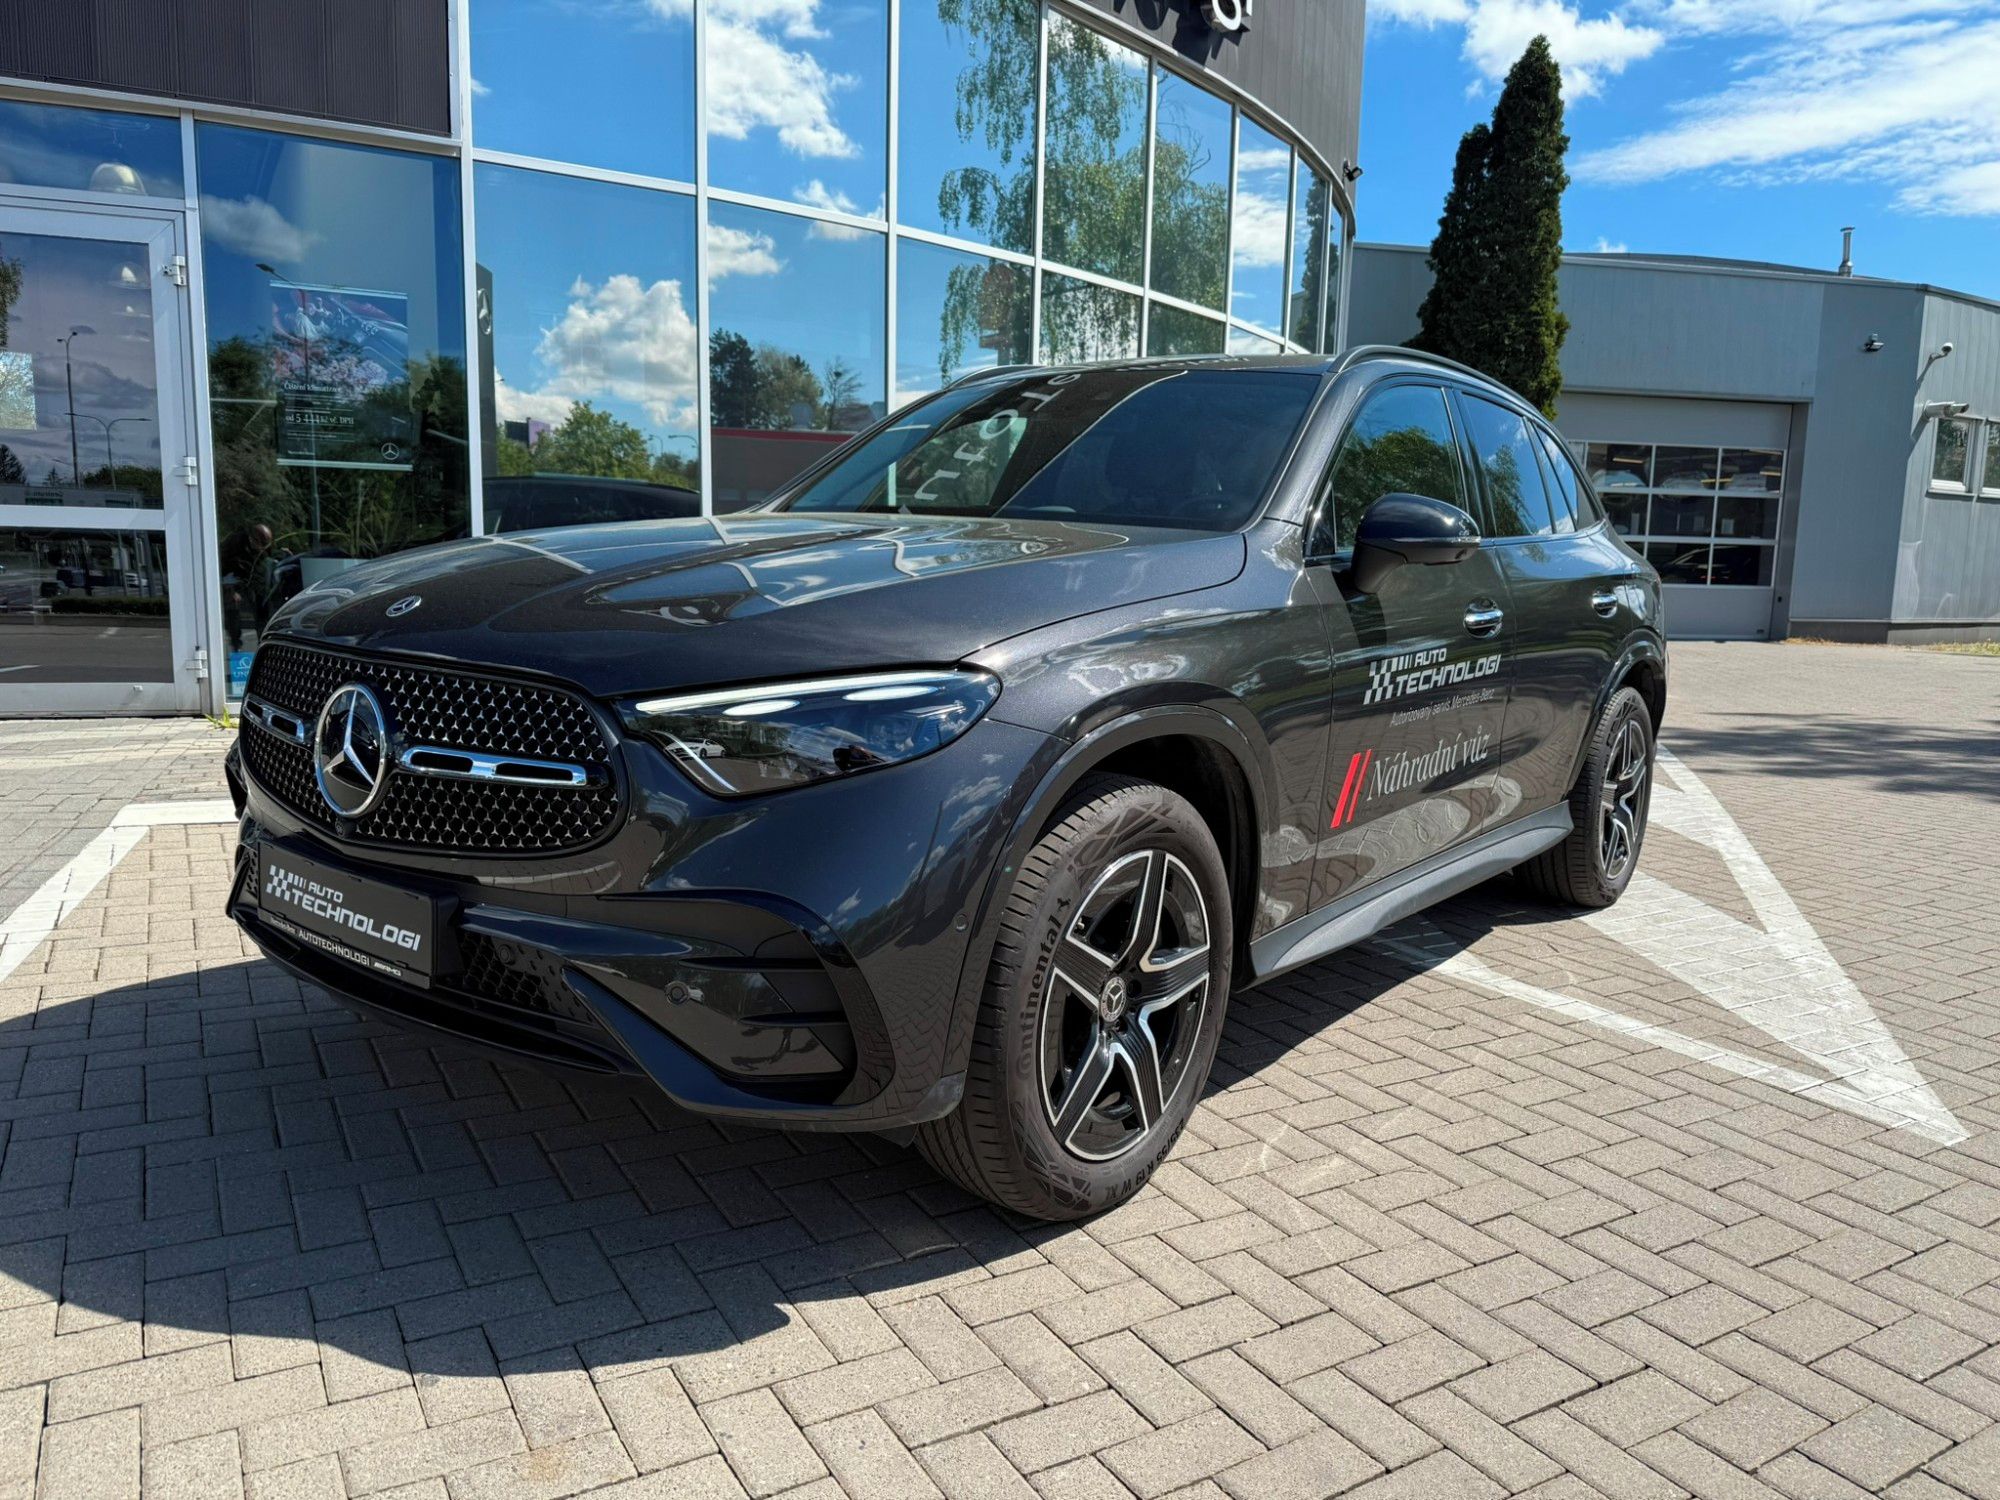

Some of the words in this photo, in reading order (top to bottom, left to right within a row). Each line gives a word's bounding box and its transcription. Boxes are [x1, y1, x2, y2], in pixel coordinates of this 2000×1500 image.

[1395, 654, 1502, 697] TECHNOLOGI
[1414, 648, 1447, 668] AUTO
[1366, 732, 1463, 801] Náhradní
[1463, 725, 1492, 767] vůz
[308, 881, 343, 903] AUTO
[291, 888, 421, 951] TECHNOLOGI
[298, 929, 370, 966] AUTOTECHNOLOGI
[1016, 914, 1062, 1080] Continental
